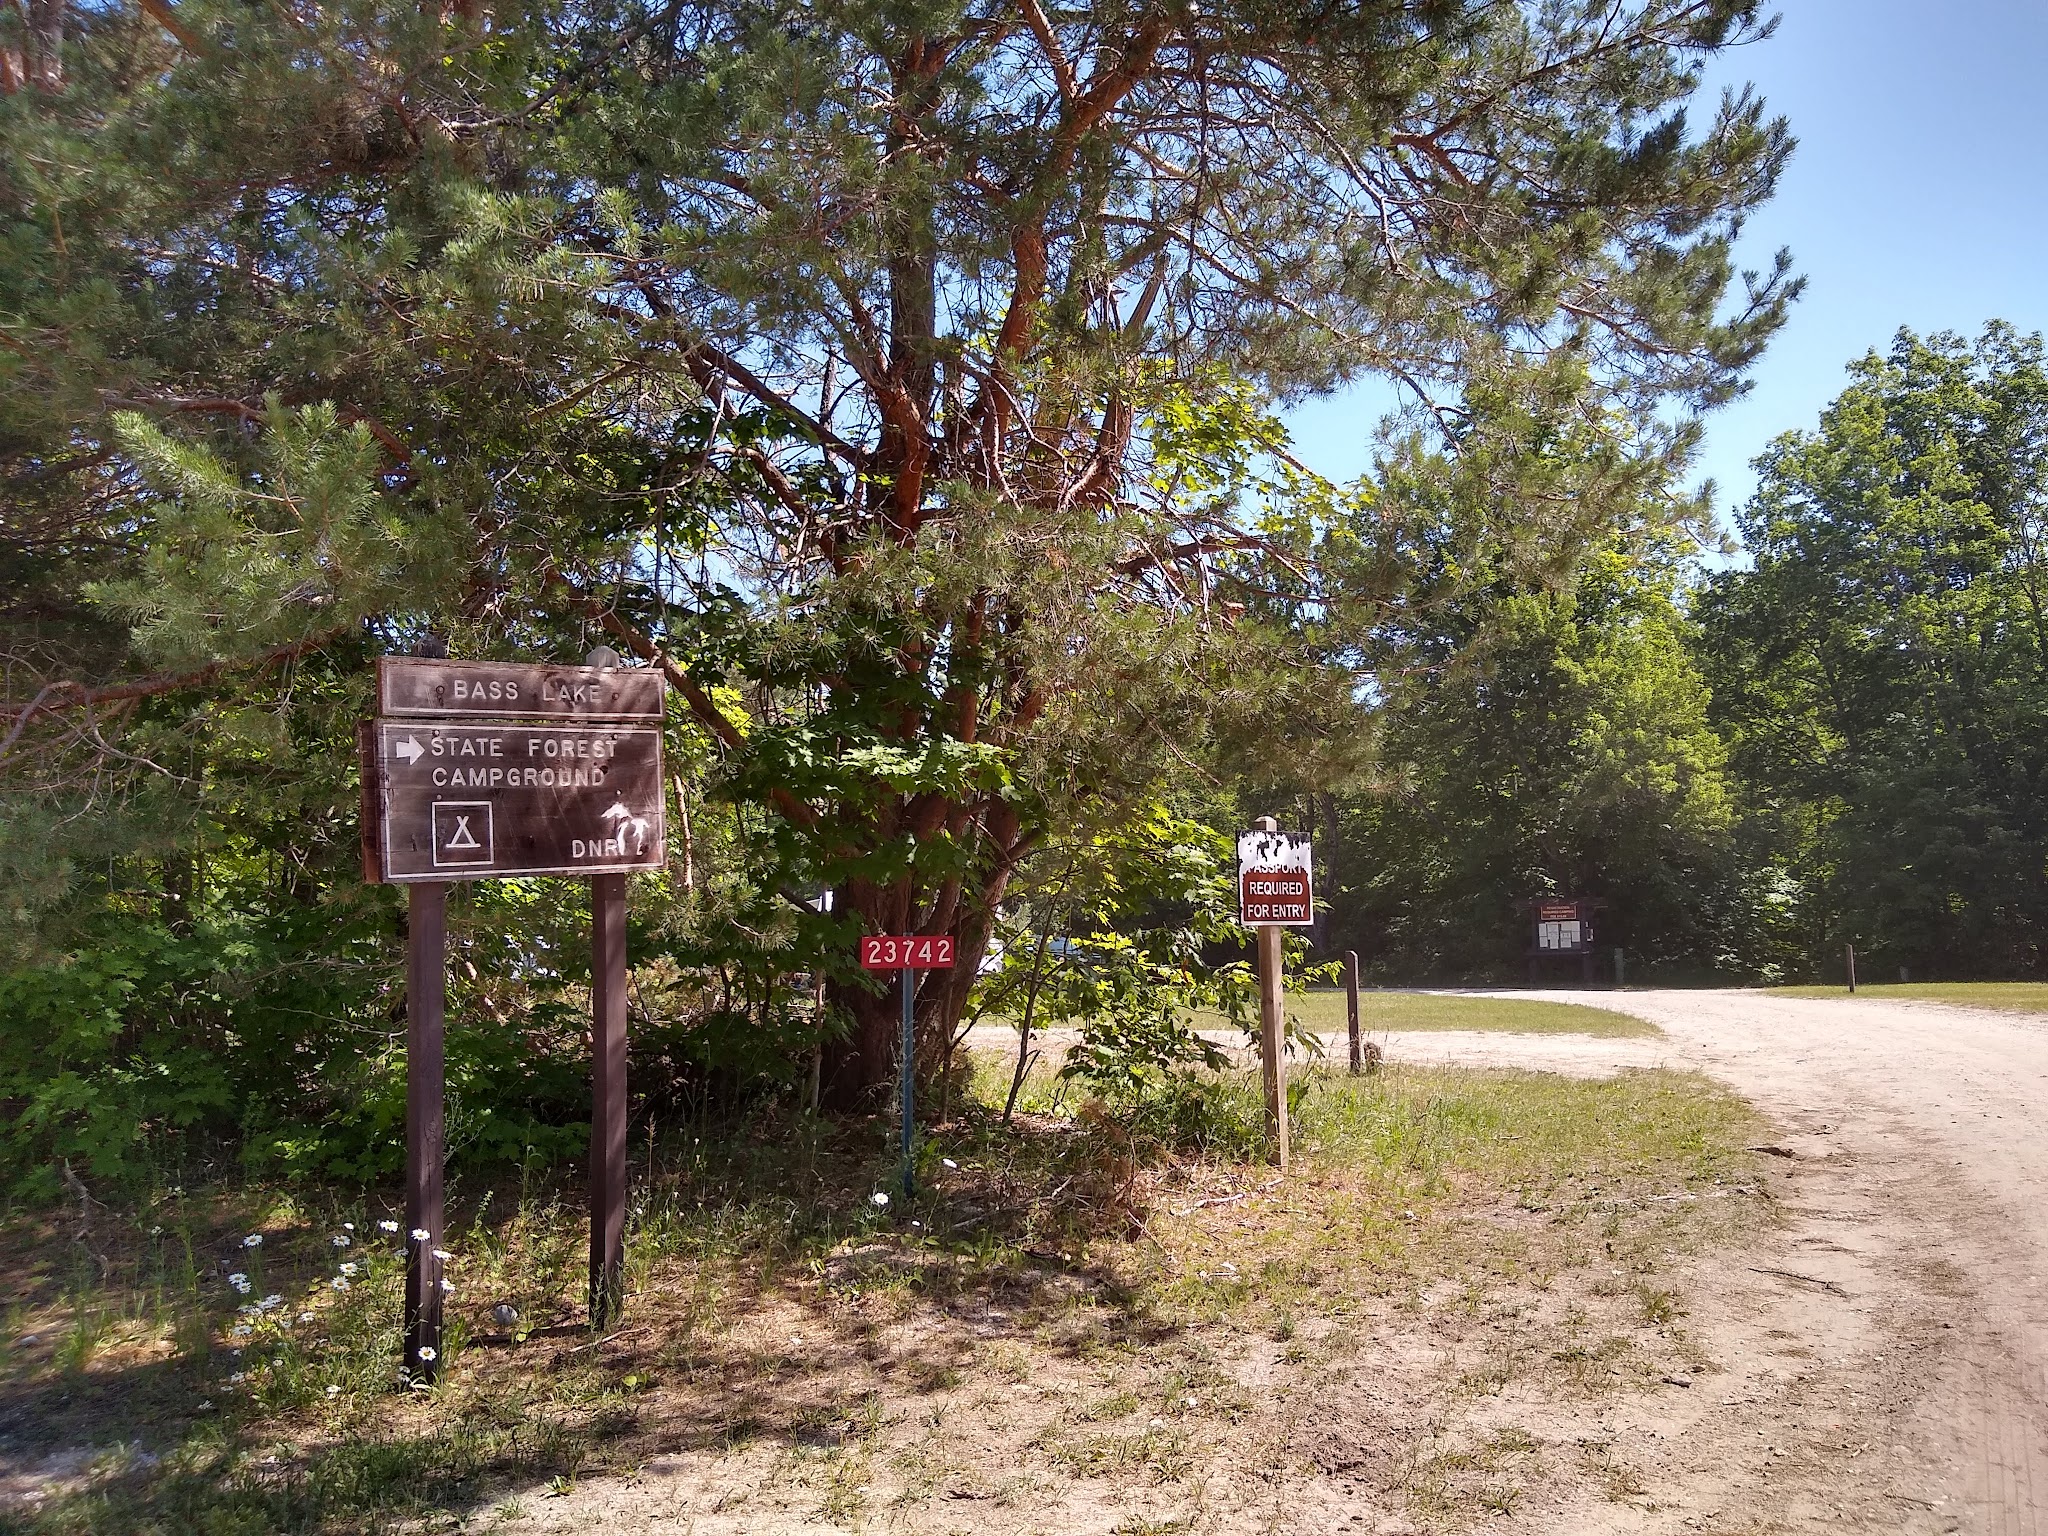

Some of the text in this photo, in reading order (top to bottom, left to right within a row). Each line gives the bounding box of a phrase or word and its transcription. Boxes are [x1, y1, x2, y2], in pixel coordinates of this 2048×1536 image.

[454, 679, 602, 702] BASS LAKE
[431, 738, 617, 758] STATE FOREST
[432, 767, 605, 787] CAMPGROUND
[572, 839, 617, 858] DNR
[1249, 882, 1303, 895] REQUIRED
[1247, 904, 1306, 918] FOR ENTRY
[868, 939, 951, 966] 23742
